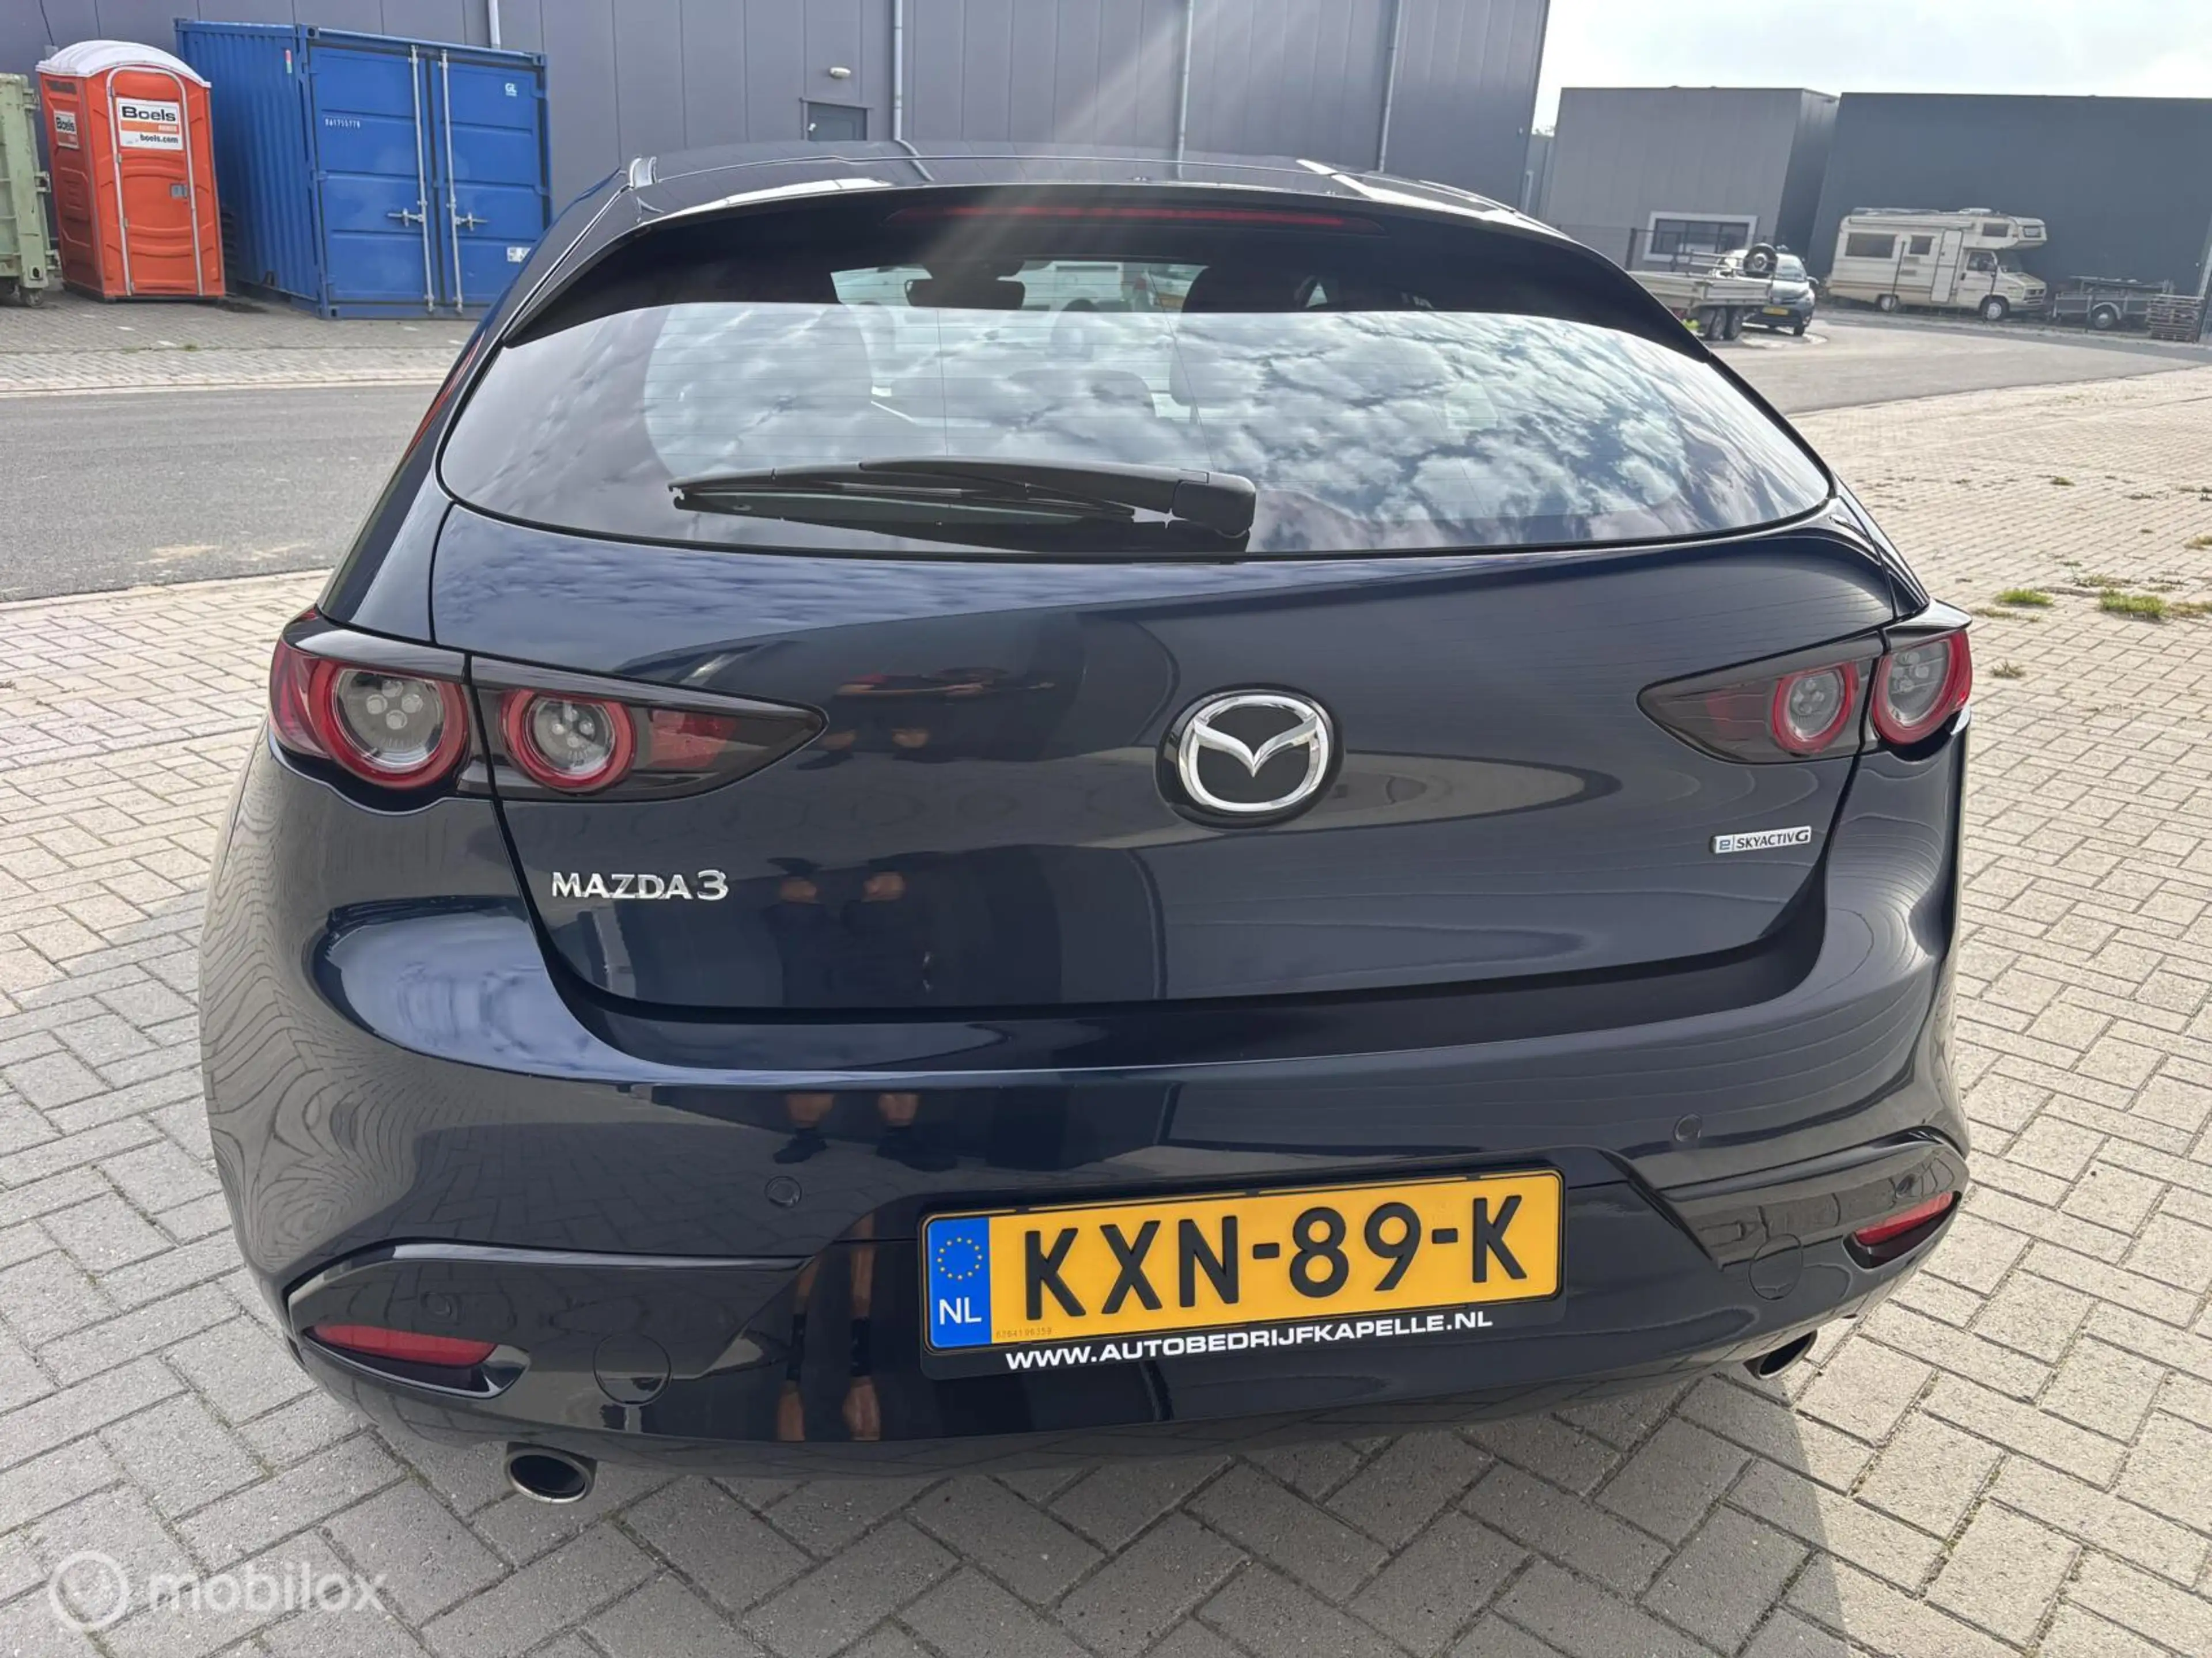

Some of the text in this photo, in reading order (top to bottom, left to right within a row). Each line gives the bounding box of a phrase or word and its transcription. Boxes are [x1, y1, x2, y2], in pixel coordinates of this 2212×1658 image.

[122, 106, 176, 122] Boels
[1025, 1194, 1527, 1321] KXN-89-K
[939, 1297, 982, 1325] NL
[1006, 1311, 1493, 1370] WWW.AUTOBEDRIJFKAPELLE.NL
